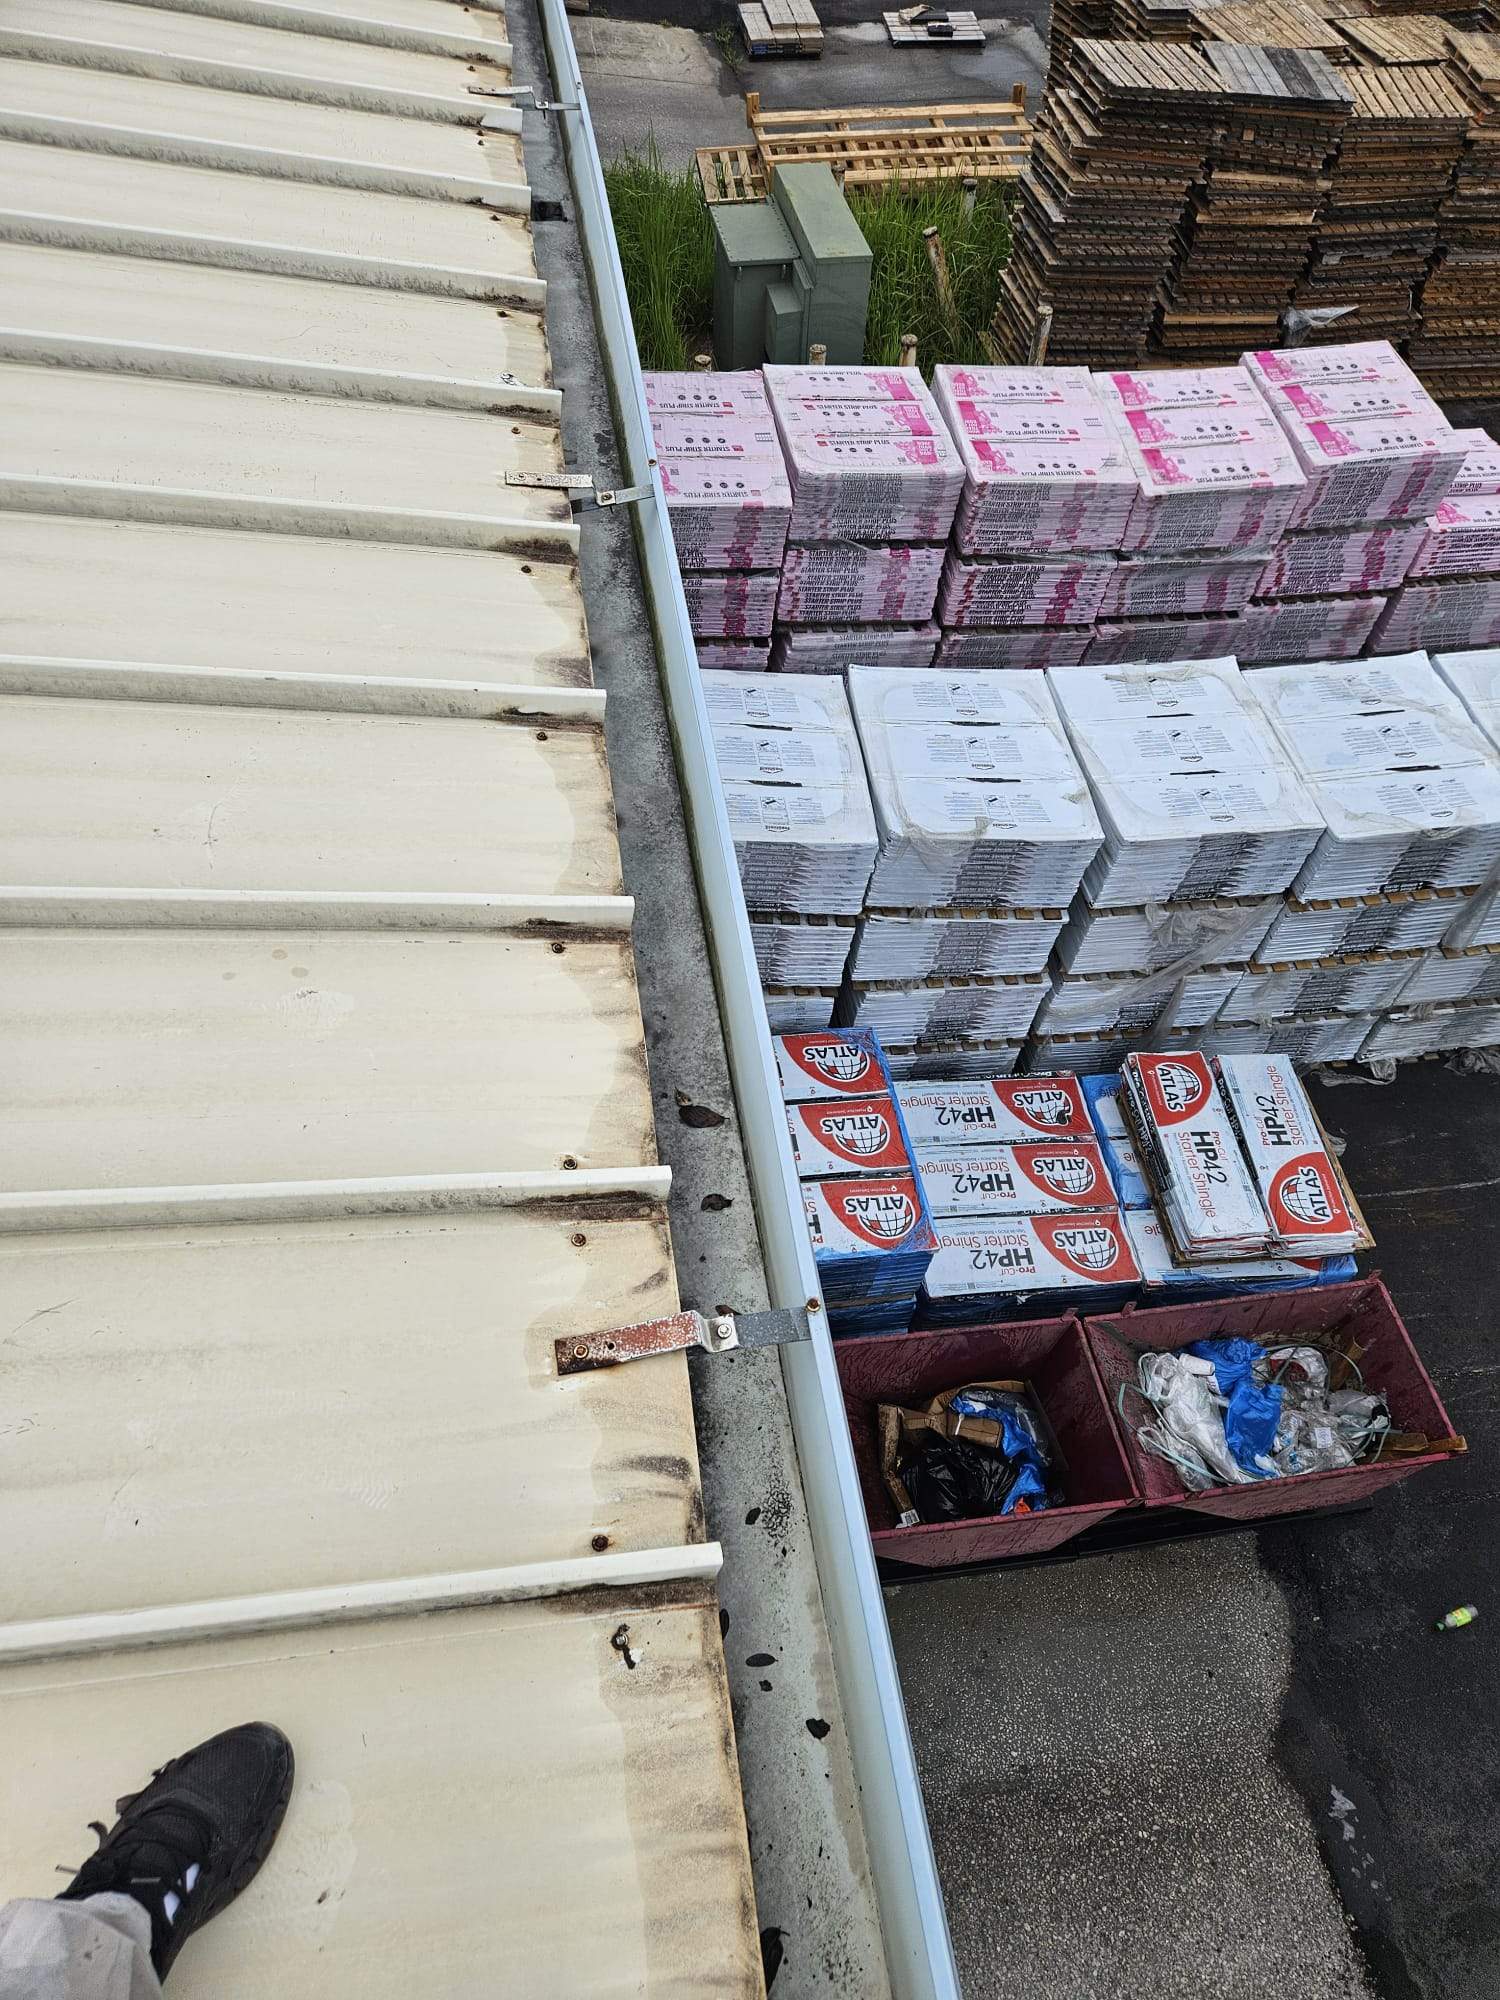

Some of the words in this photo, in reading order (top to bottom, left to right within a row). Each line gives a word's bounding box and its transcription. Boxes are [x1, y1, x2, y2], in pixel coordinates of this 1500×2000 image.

[804, 1045, 859, 1060] ATLAS
[1158, 1068, 1184, 1111] ATLAS
[1266, 1065, 1290, 1106] Shingle
[900, 1096, 945, 1108] Shingle
[948, 1095, 991, 1106] Starter
[1014, 1091, 1063, 1106] ATLAS
[822, 1116, 879, 1132] ATLAS
[935, 1106, 995, 1126] HP42
[1256, 1095, 1292, 1147] HP42
[964, 1123, 997, 1131] Pro-Cut
[1254, 1117, 1270, 1146] Pro-Cut
[1282, 1108, 1305, 1146] Starter
[1211, 1131, 1228, 1161] Pro-Cut
[1033, 1158, 1085, 1173] ATLAS
[1190, 1131, 1228, 1184] HP42
[966, 1161, 1010, 1172] Starter
[1177, 1131, 1199, 1171] Starter
[1192, 1172, 1217, 1218] Shingle
[952, 1173, 1015, 1193] HP42
[981, 1191, 1017, 1200] Pro-Cut
[1304, 1168, 1330, 1218] ATLAS
[845, 1196, 904, 1212] ATLAS
[941, 1236, 981, 1248] Shingl
[982, 1234, 1030, 1247] Starter
[1055, 1230, 1107, 1247] ATLAS
[970, 1248, 1035, 1270] HP42
[1000, 1266, 1036, 1275] Pro-Cut
